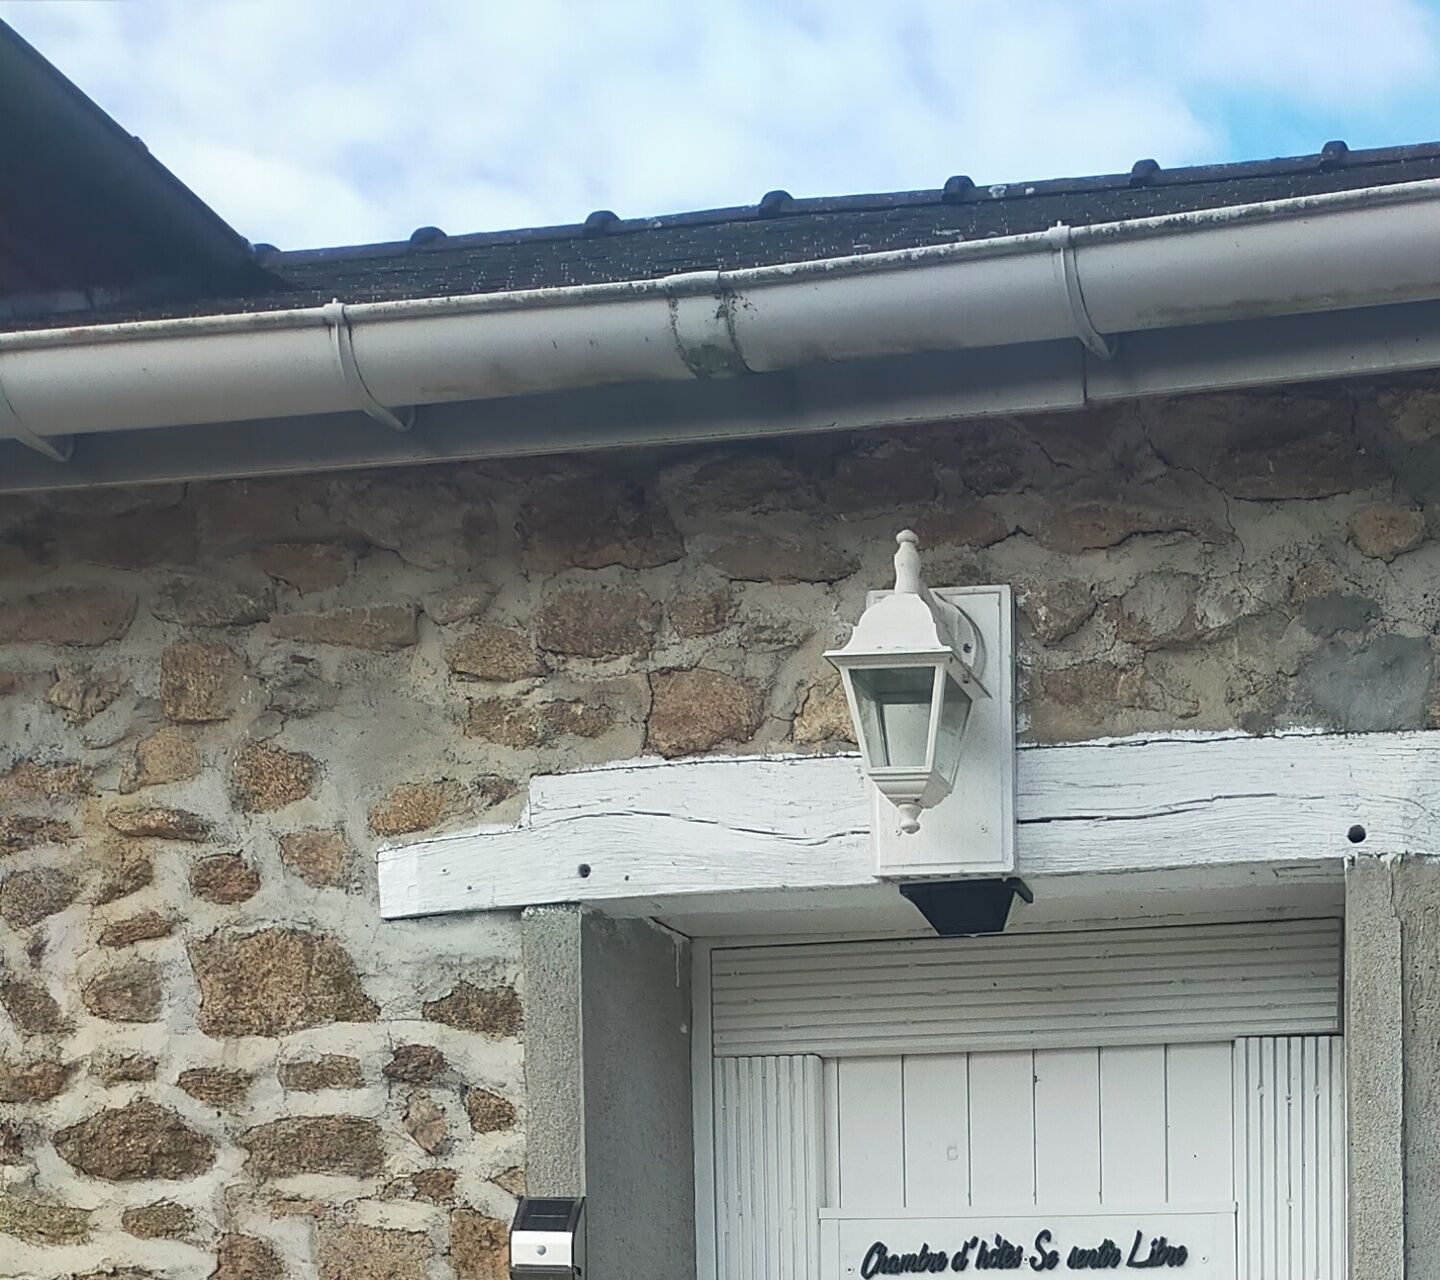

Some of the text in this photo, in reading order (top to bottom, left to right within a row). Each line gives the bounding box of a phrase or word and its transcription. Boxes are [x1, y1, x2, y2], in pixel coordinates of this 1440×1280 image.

[861, 1241, 949, 1280] Chambre
[1029, 1229, 1060, 1272] Se
[1067, 1238, 1122, 1269] sentir
[1126, 1230, 1188, 1268] Libre
